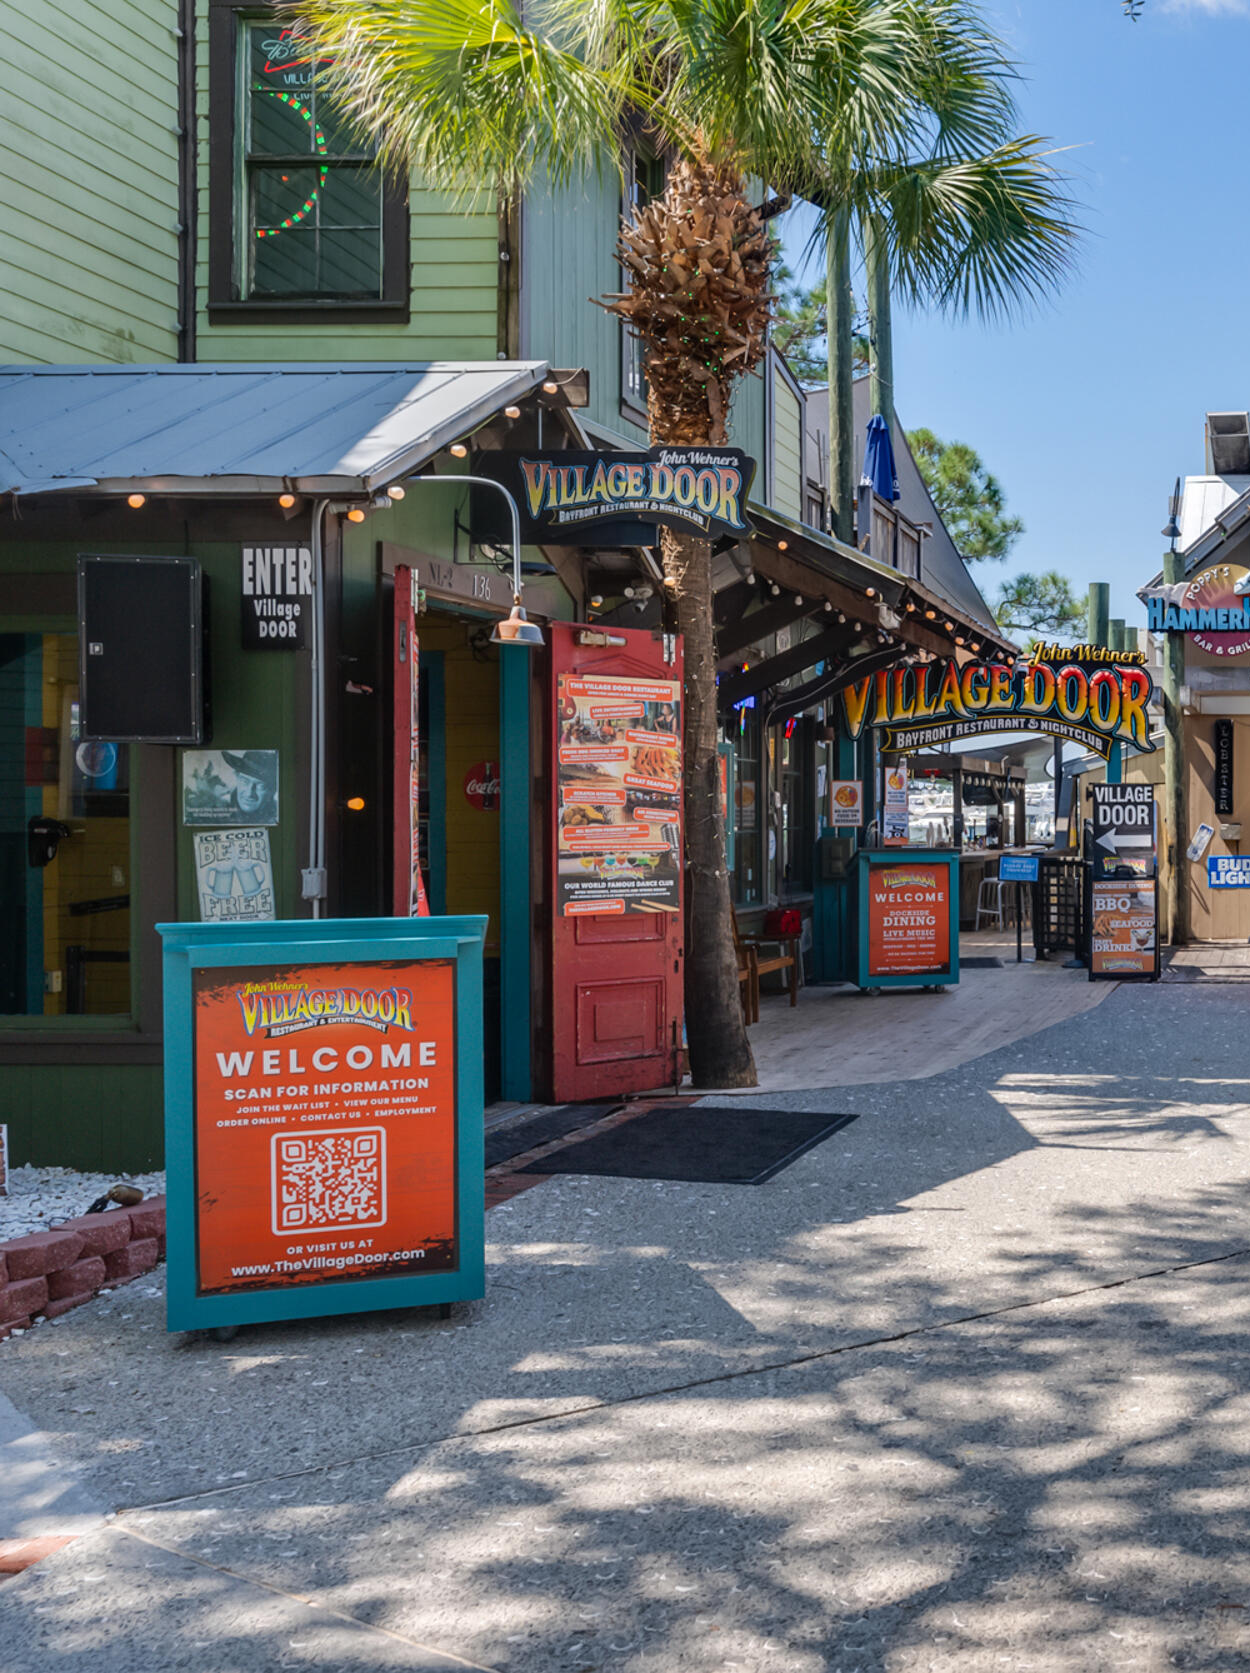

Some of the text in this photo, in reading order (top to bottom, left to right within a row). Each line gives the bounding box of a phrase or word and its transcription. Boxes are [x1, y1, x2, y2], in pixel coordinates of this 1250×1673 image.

[655, 450, 739, 468] John Wehner's
[521, 459, 745, 528] VILLAGE DOOR
[559, 501, 704, 526] BAYFRONT RESTAURANT & NIGHTCLUB
[243, 547, 313, 595] ENTER
[472, 574, 491, 601] 136
[1186, 565, 1231, 601] POPPY'S
[253, 599, 301, 621] Village
[259, 620, 297, 638] DOOR
[1028, 640, 1147, 667] John Wehner's
[1193, 633, 1213, 652] BAR
[1215, 645, 1224, 655] &
[842, 660, 1153, 751] VILLAGE DOOR
[896, 717, 1104, 750] BAYFRONT RESTAURANT & NIGHTCLUB
[1094, 786, 1153, 802] VILLAGE
[1099, 804, 1150, 826] DOOR
[200, 830, 265, 844] ICE COLD
[199, 838, 268, 869] BEER
[581, 881, 607, 889] WORLD
[607, 880, 636, 889] FAMOUS
[203, 887, 272, 918] FREE
[875, 892, 945, 903] WELCOME
[1095, 898, 1131, 914] BBQ
[882, 916, 936, 927] DINING
[889, 909, 930, 917] DOCKSIDE
[1109, 919, 1155, 929] SEAFOOD
[906, 929, 936, 937] MUSIC
[1095, 943, 1137, 953] DRINKS
[242, 982, 267, 998] John
[237, 986, 415, 1036] VILLAGE DOOR
[270, 1019, 318, 1038] RESTAURANT
[327, 1017, 388, 1034] ENTERTAINMENT
[215, 1042, 437, 1078] WELCOME
[223, 1077, 430, 1101] SCAN FOR INFORMATION
[236, 1095, 419, 1114] JOIN THE WAIT LIST VIEW OUR MENU
[216, 1105, 438, 1128] ORDER ONLINE CONTACT US EMPLOYMENT
[286, 1238, 374, 1255] OR VISIT US AT
[231, 1249, 426, 1277] www.TheVillageDoor.com
